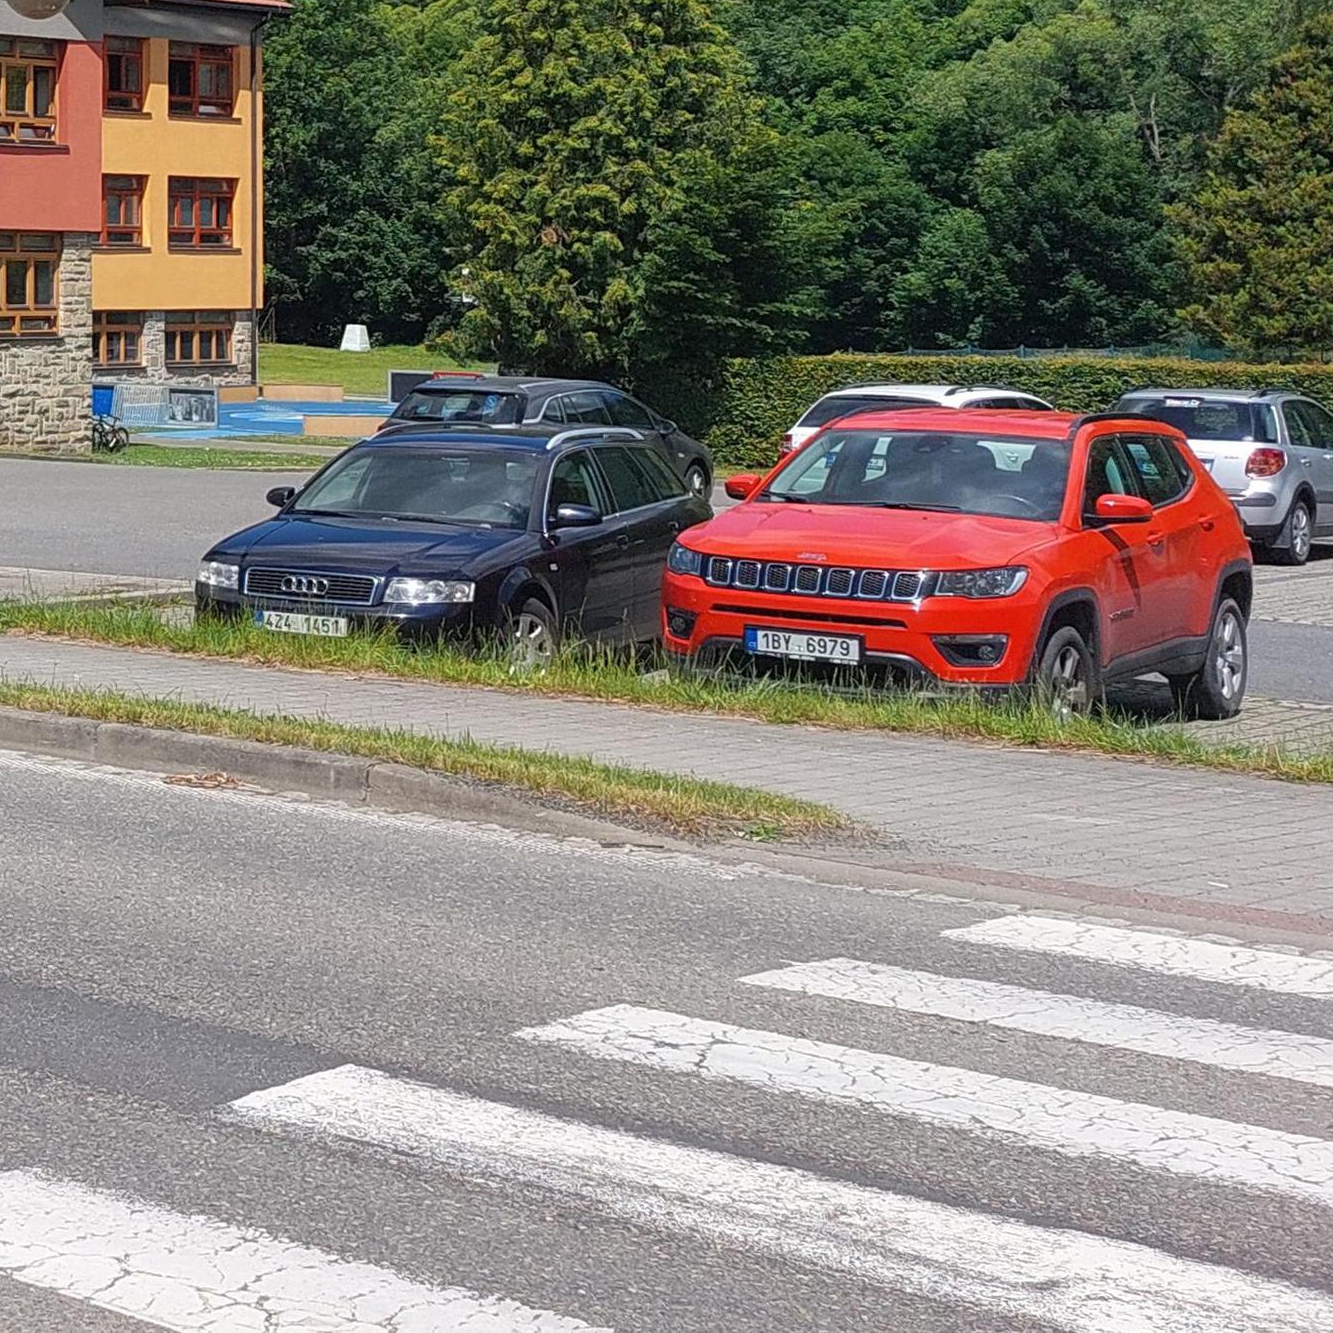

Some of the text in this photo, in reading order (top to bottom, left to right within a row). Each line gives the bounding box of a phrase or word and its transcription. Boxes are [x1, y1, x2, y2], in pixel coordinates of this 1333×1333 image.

[265, 613, 339, 634] 4Z4 1451
[762, 632, 791, 651] 1BY
[806, 637, 850, 656] 6979
